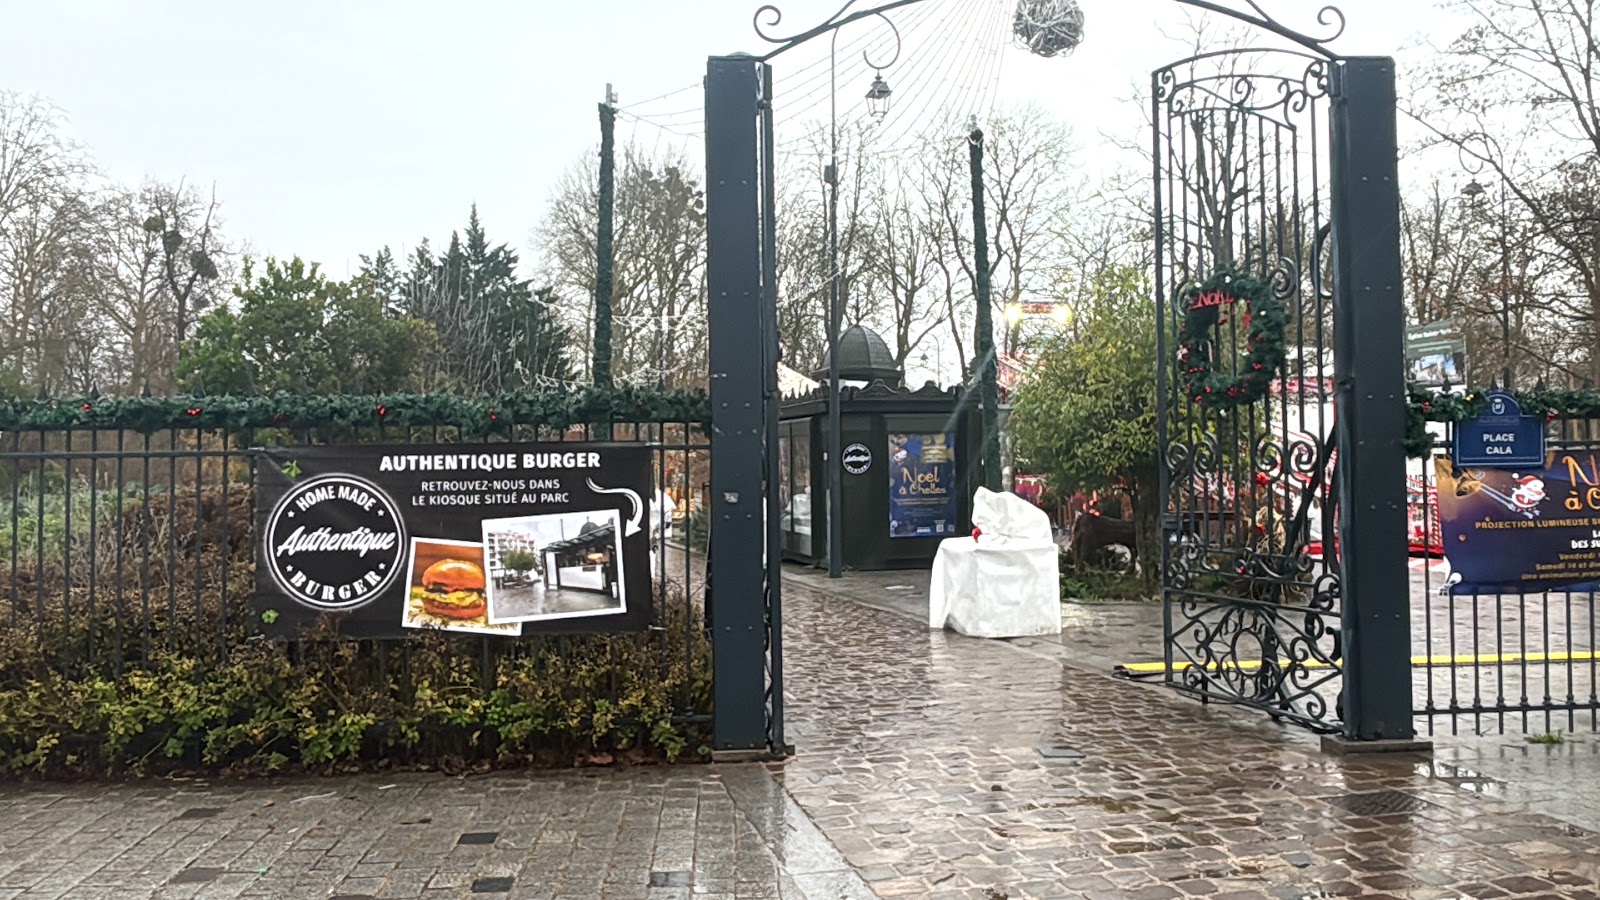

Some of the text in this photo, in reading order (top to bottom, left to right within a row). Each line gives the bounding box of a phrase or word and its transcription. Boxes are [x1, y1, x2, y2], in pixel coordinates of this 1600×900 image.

[1482, 433, 1515, 442] PLACE
[1485, 446, 1513, 455] CALA
[379, 452, 601, 472] AUTHENTIQUE BURGER
[421, 479, 561, 492] RETROUVEZ-NOUS DANS
[909, 483, 947, 495] Chelles
[295, 485, 377, 512] HOME MADE
[412, 492, 570, 506] LE KIOSQUE SITUÉ AU PARC
[1564, 491, 1583, 510] à
[1474, 520, 1535, 529] PROJECTION
[1536, 518, 1590, 528] LUMINEUSE
[276, 525, 396, 558] Authentique
[1571, 540, 1589, 549] DES
[1558, 552, 1596, 560] Vendredi
[1535, 562, 1566, 571] Samedi
[290, 570, 382, 601] BURGER
